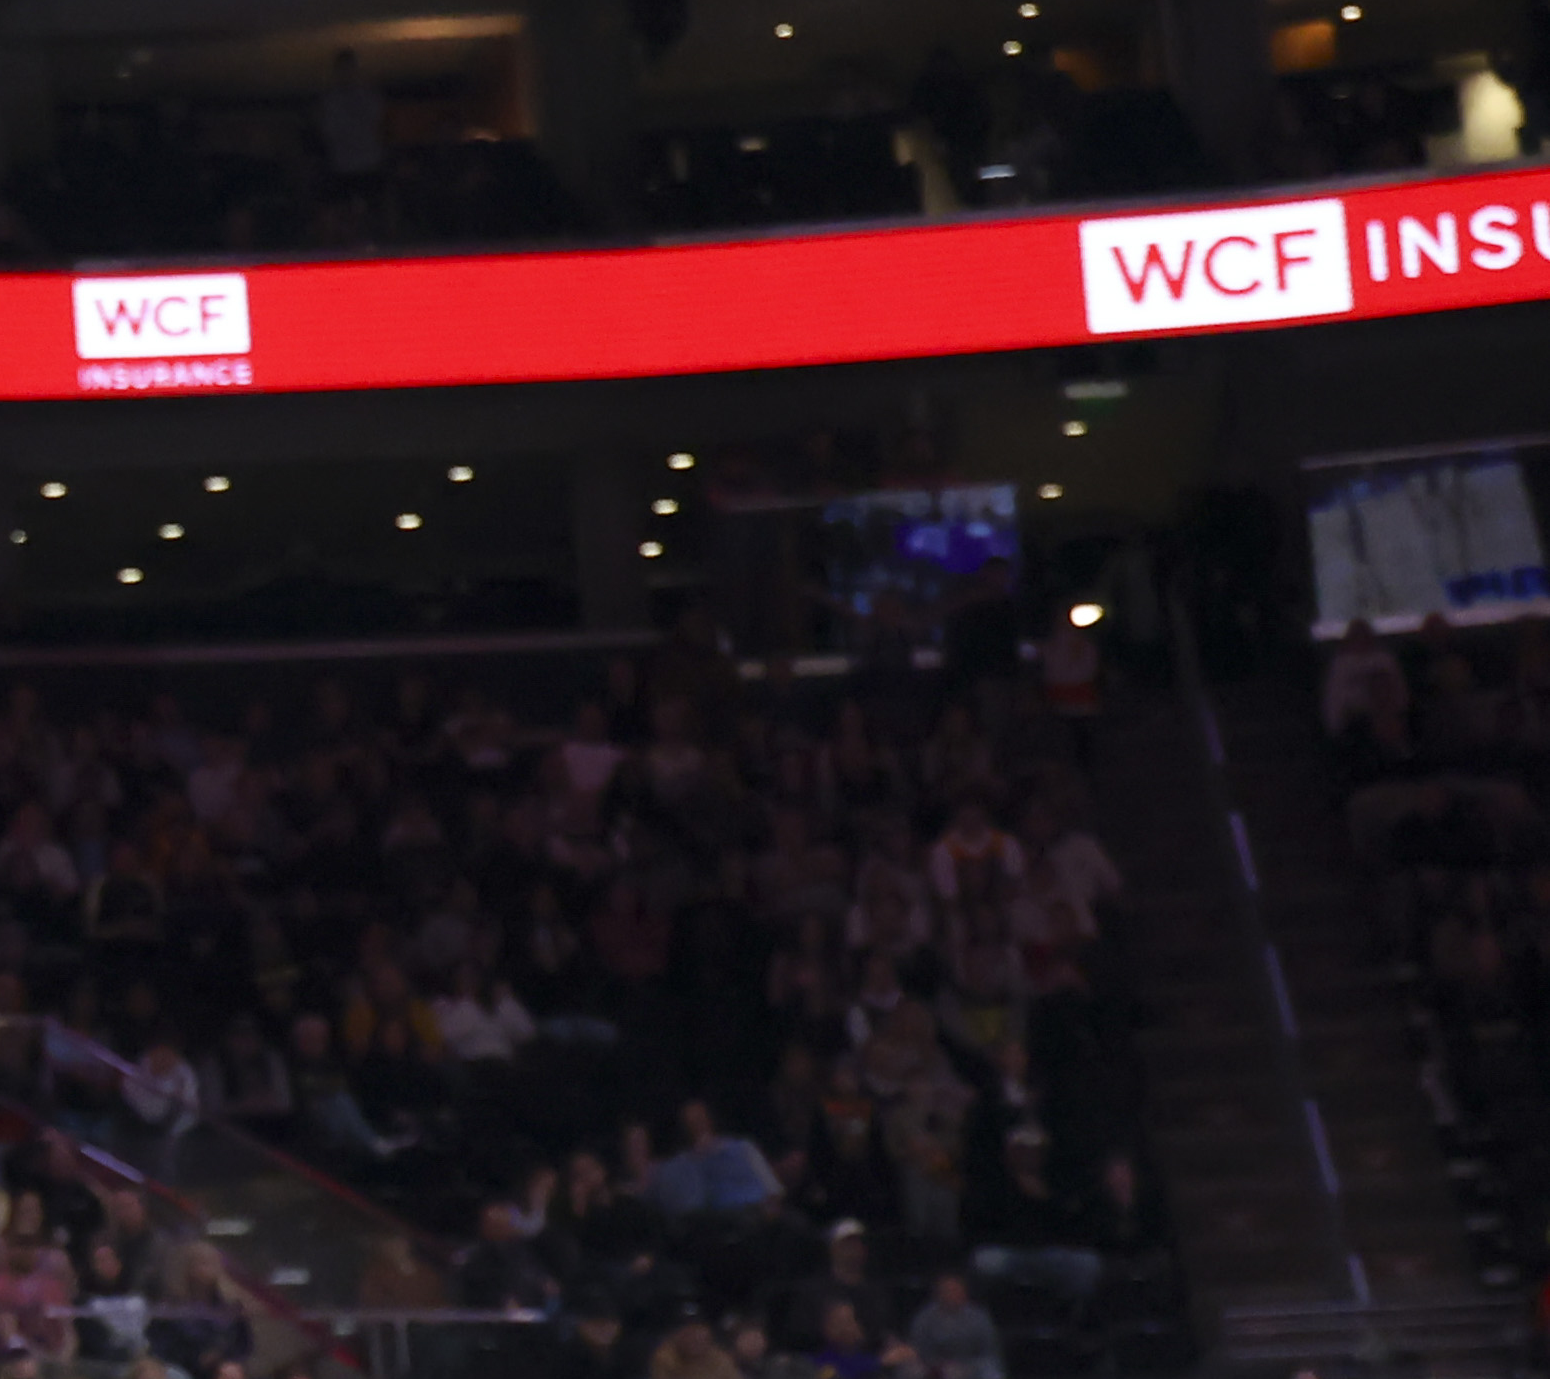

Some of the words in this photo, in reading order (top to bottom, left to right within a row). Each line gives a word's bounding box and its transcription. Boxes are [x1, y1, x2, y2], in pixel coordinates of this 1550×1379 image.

[1112, 227, 1320, 306] WCF
[94, 294, 228, 339] WCF
[77, 359, 254, 391] INSURANCE
